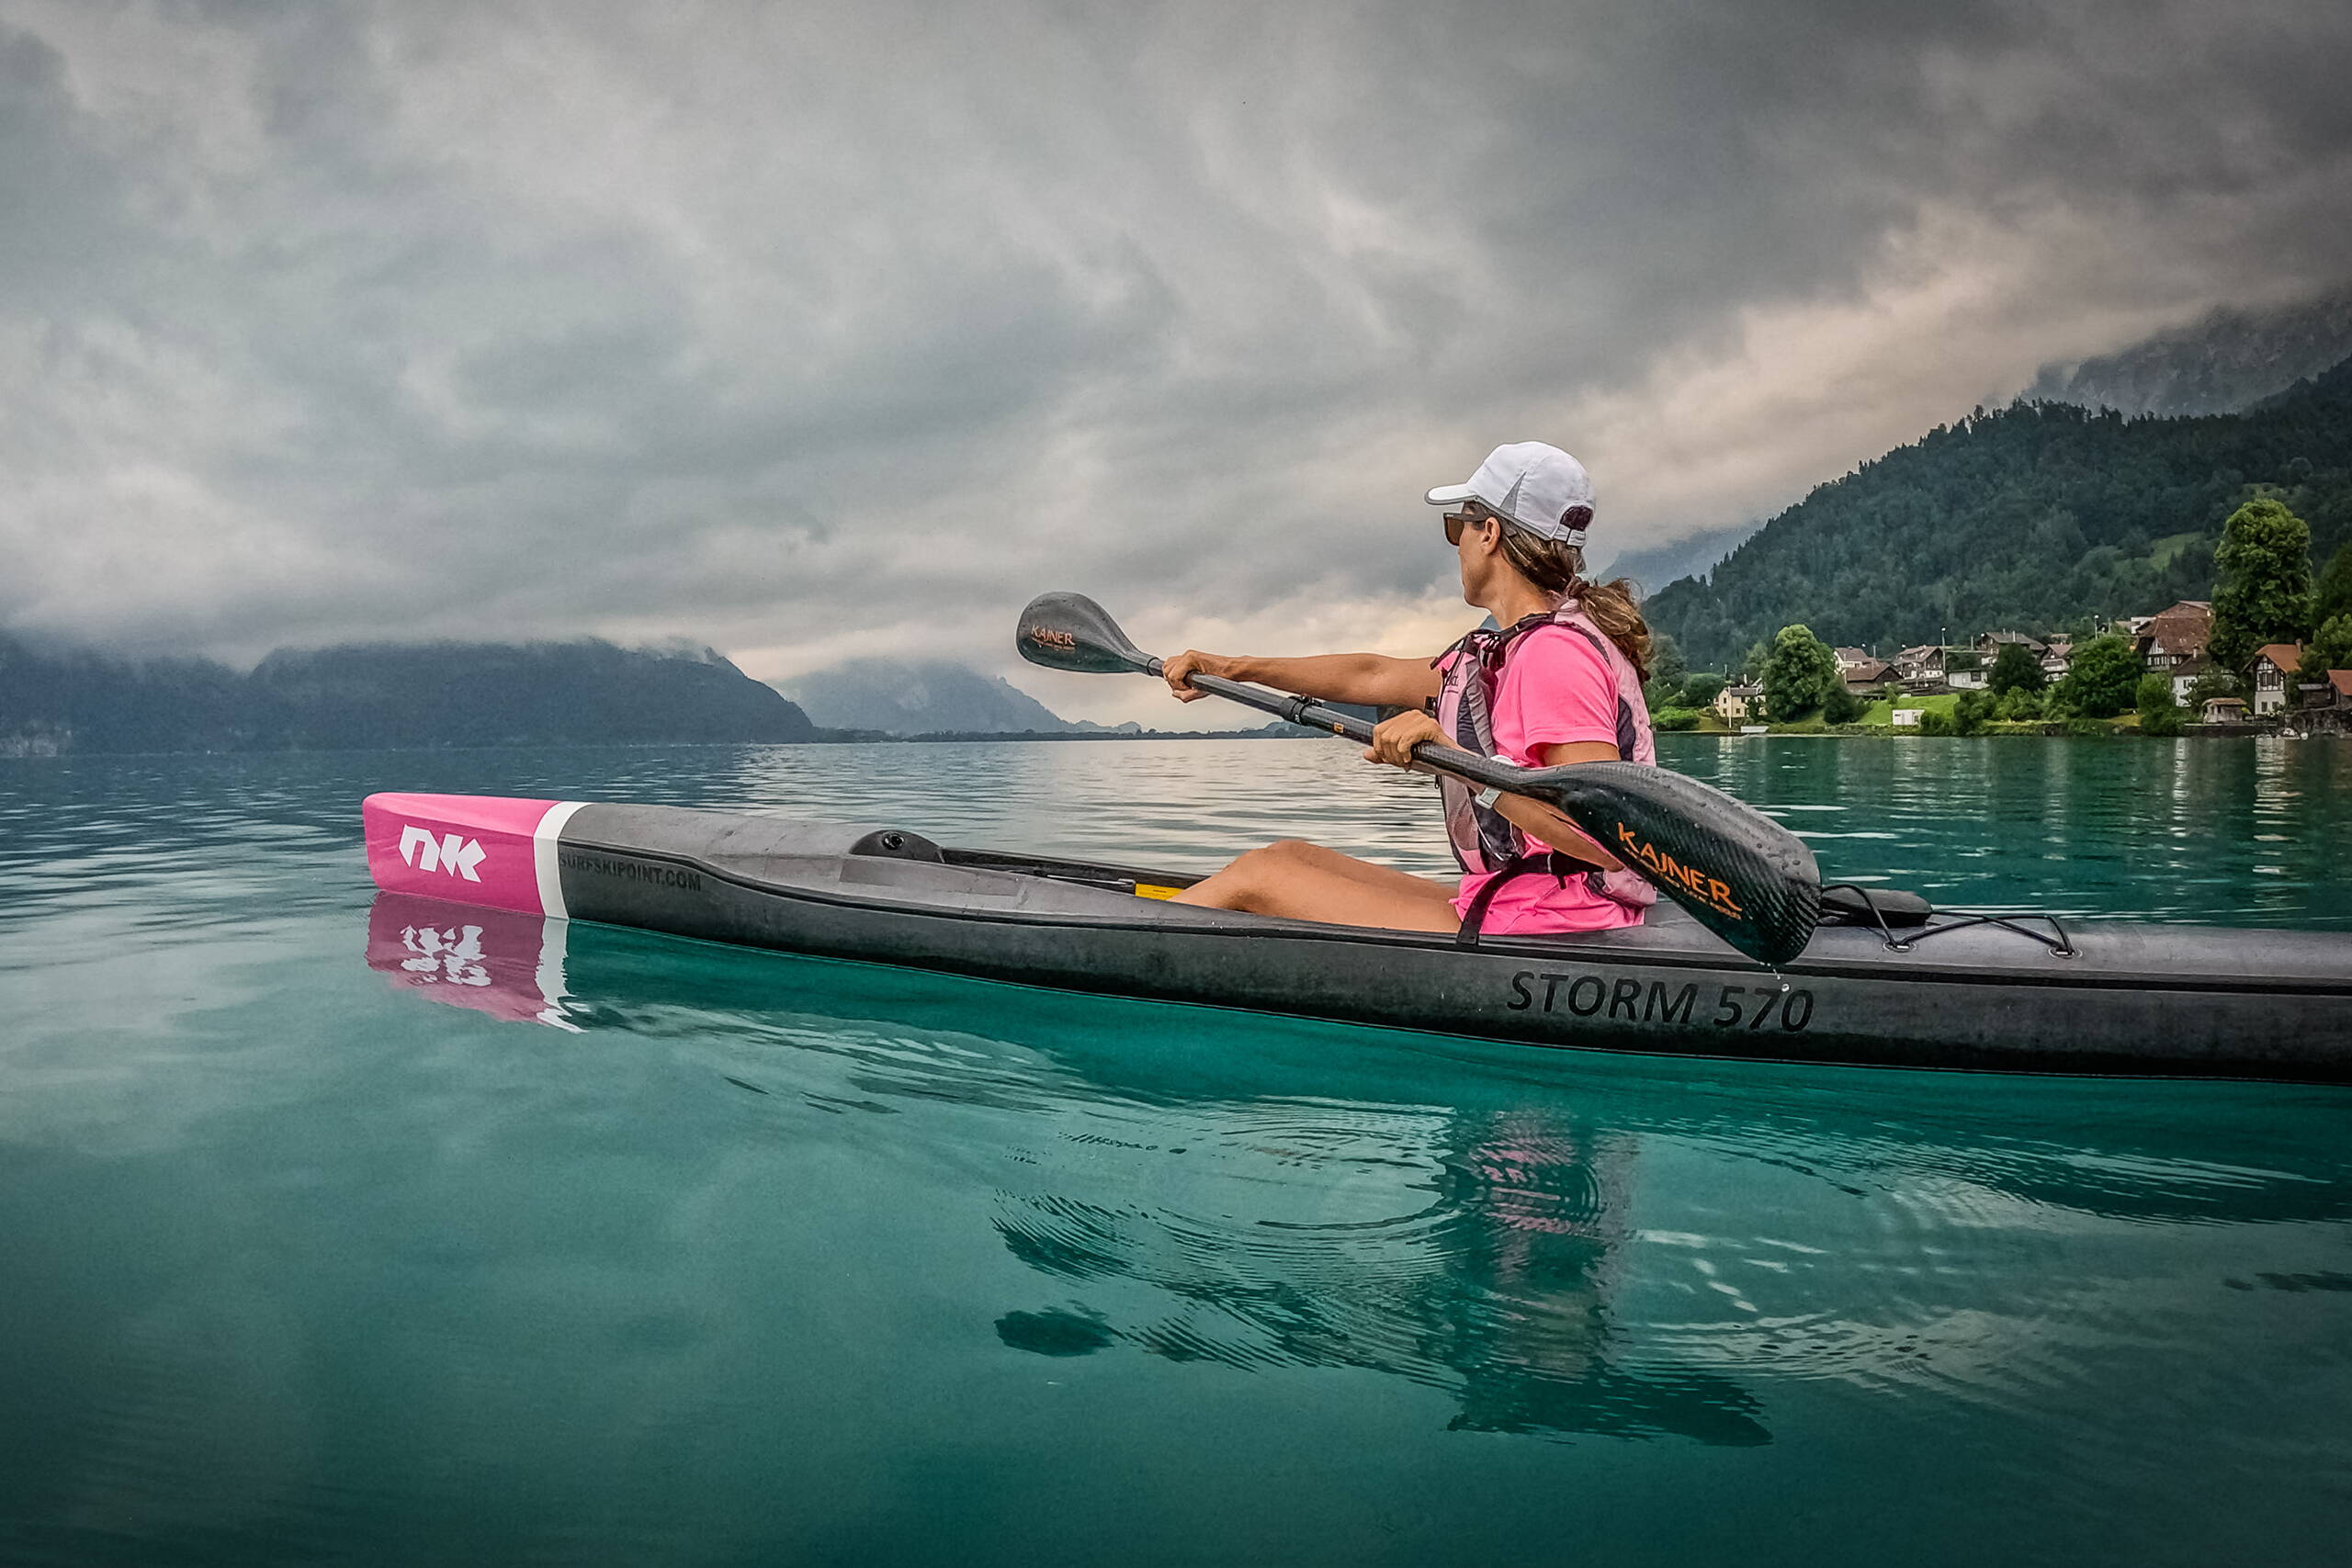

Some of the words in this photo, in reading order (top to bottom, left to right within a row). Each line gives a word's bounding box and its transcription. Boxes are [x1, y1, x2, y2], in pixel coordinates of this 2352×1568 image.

[559, 852, 701, 892] SURFSKIPOINT.COM
[1507, 971, 1699, 1024] STORM
[1713, 987, 1815, 1032] 570
